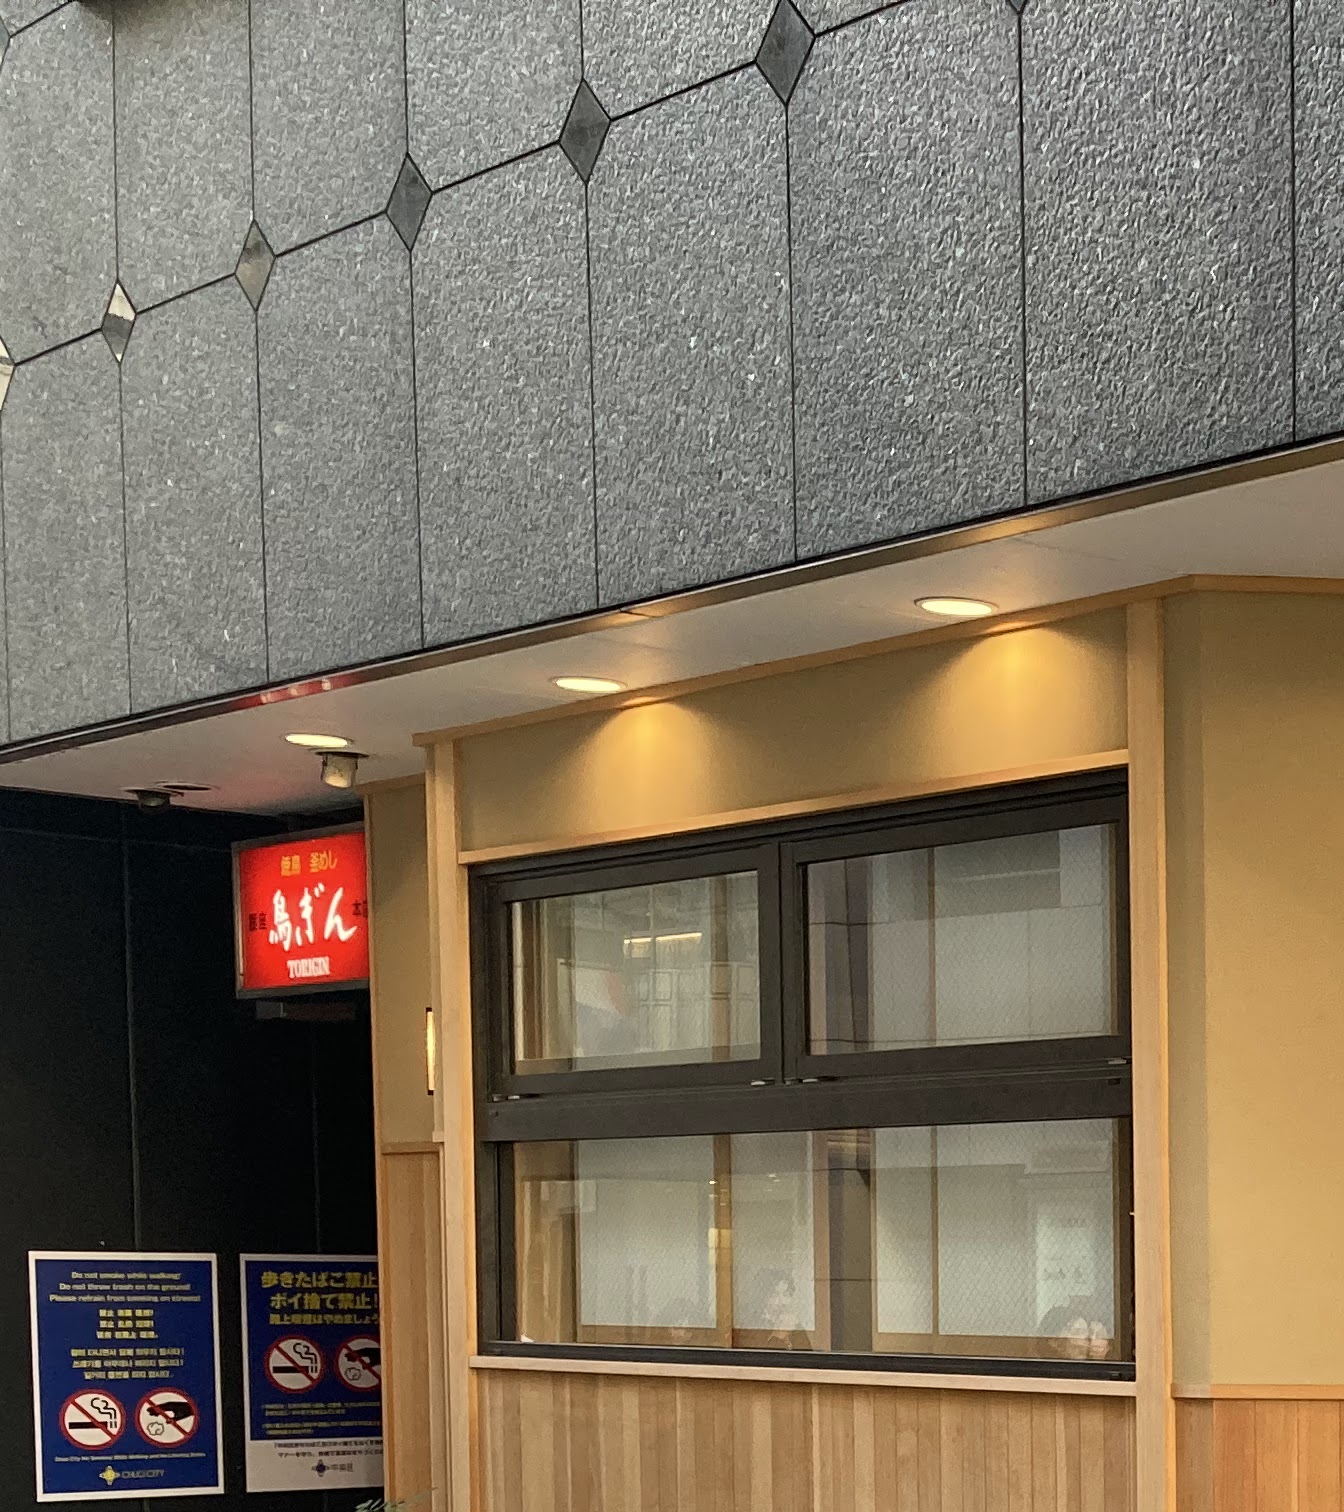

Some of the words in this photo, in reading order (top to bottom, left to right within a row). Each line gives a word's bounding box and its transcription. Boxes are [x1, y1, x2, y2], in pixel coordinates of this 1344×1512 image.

[269, 883, 358, 951] 鳥ぎん
[287, 956, 330, 978] TORIGIN
